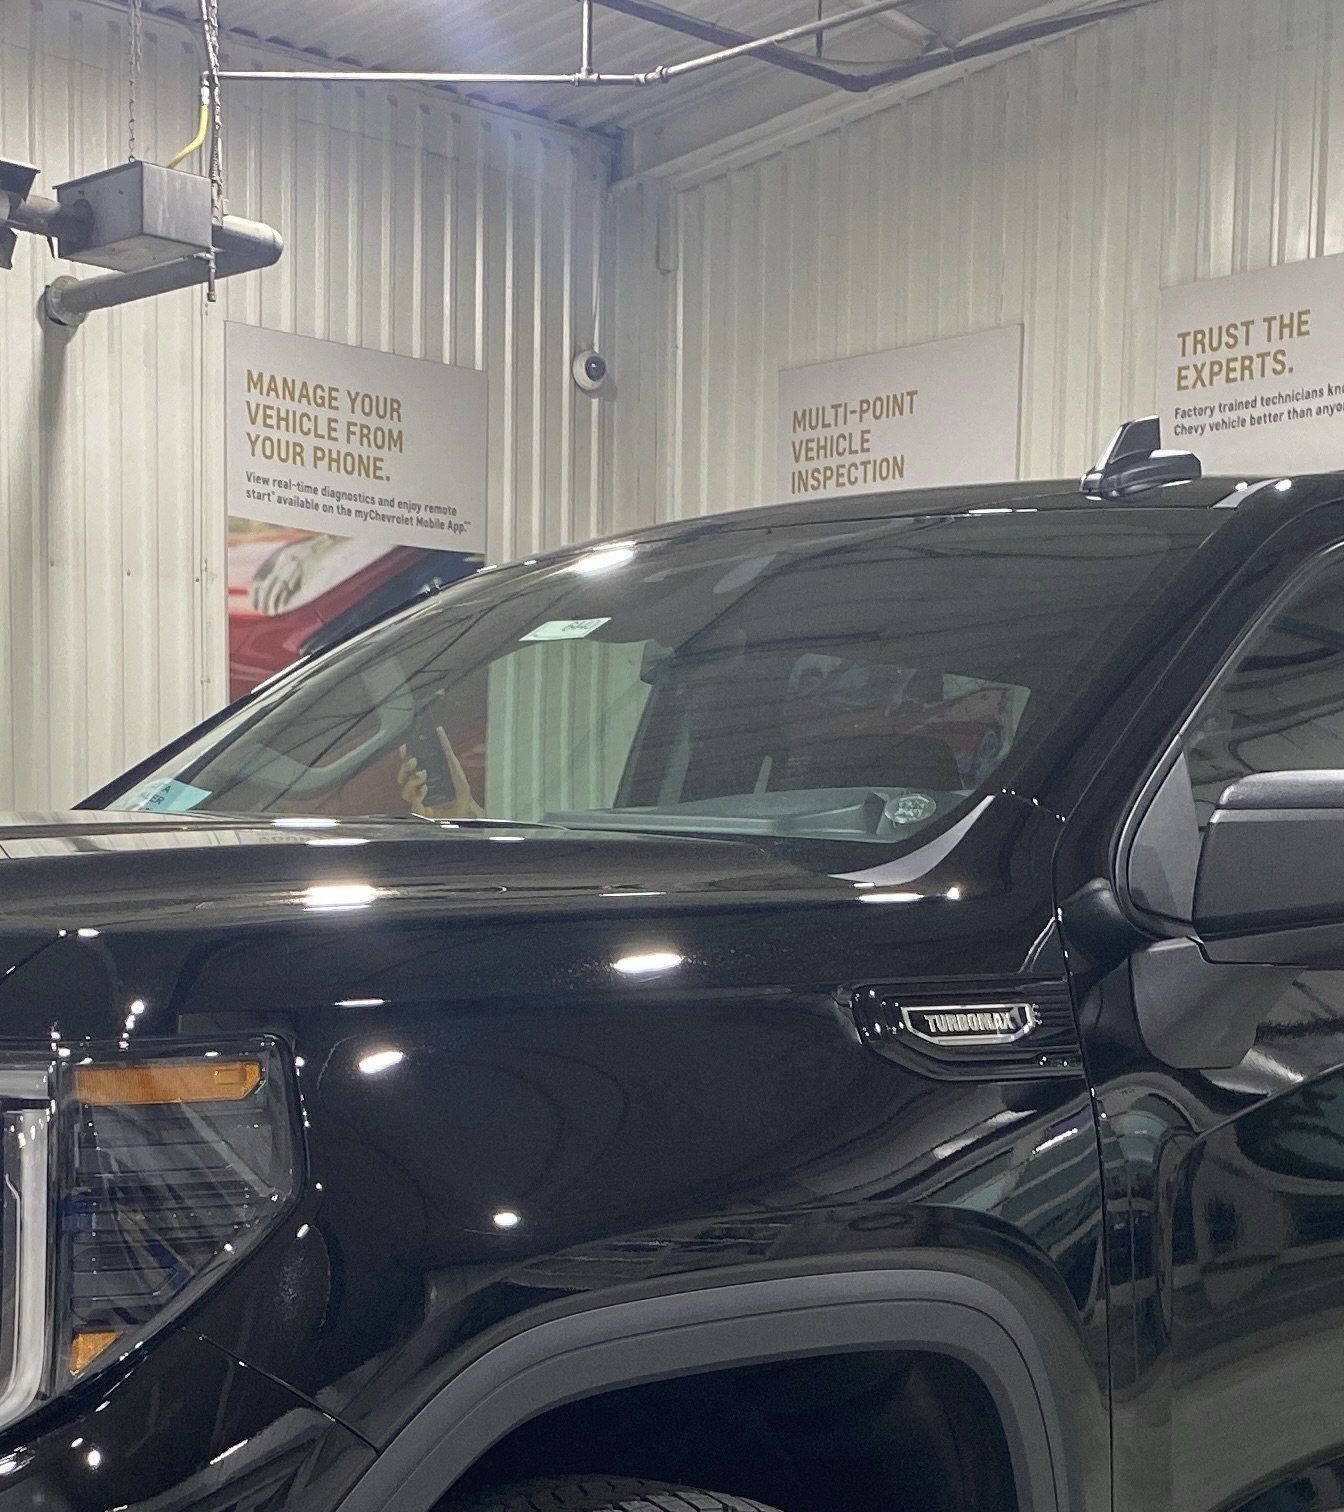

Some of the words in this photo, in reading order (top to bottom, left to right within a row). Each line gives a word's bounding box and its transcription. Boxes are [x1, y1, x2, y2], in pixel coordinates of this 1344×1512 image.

[1177, 320, 1255, 357] TRUST
[1262, 308, 1311, 342] THE
[1176, 349, 1294, 391] EXPERTS.
[246, 369, 340, 411] MANAGE
[346, 389, 402, 422] YOUR
[793, 390, 918, 433] MULTI-POINT
[1174, 403, 1216, 421] Factory
[1218, 396, 1257, 414] trained
[1260, 386, 1324, 408] technicians
[246, 400, 339, 442] VEHICLE
[346, 421, 404, 453] FROM
[1174, 421, 1206, 436] Chevy
[1209, 415, 1247, 433] vehicle
[1249, 410, 1284, 427] better
[1287, 405, 1313, 422] than
[246, 432, 305, 468] YOUR
[313, 446, 391, 482] PHONE.
[791, 429, 871, 463] VEHICLE
[246, 470, 270, 486] View
[272, 477, 318, 496] real-time
[321, 485, 376, 507] diagnostics
[378, 495, 395, 508] and
[398, 499, 422, 515] enjoy
[424, 504, 457, 516] remote
[791, 454, 905, 494] INSPECTION
[277, 492, 320, 512] available
[322, 503, 334, 514] on
[337, 504, 352, 517] the
[355, 508, 414, 527] myChevrolet
[416, 515, 445, 530] Mobile
[923, 1011, 1016, 1033] TURBOMAX
